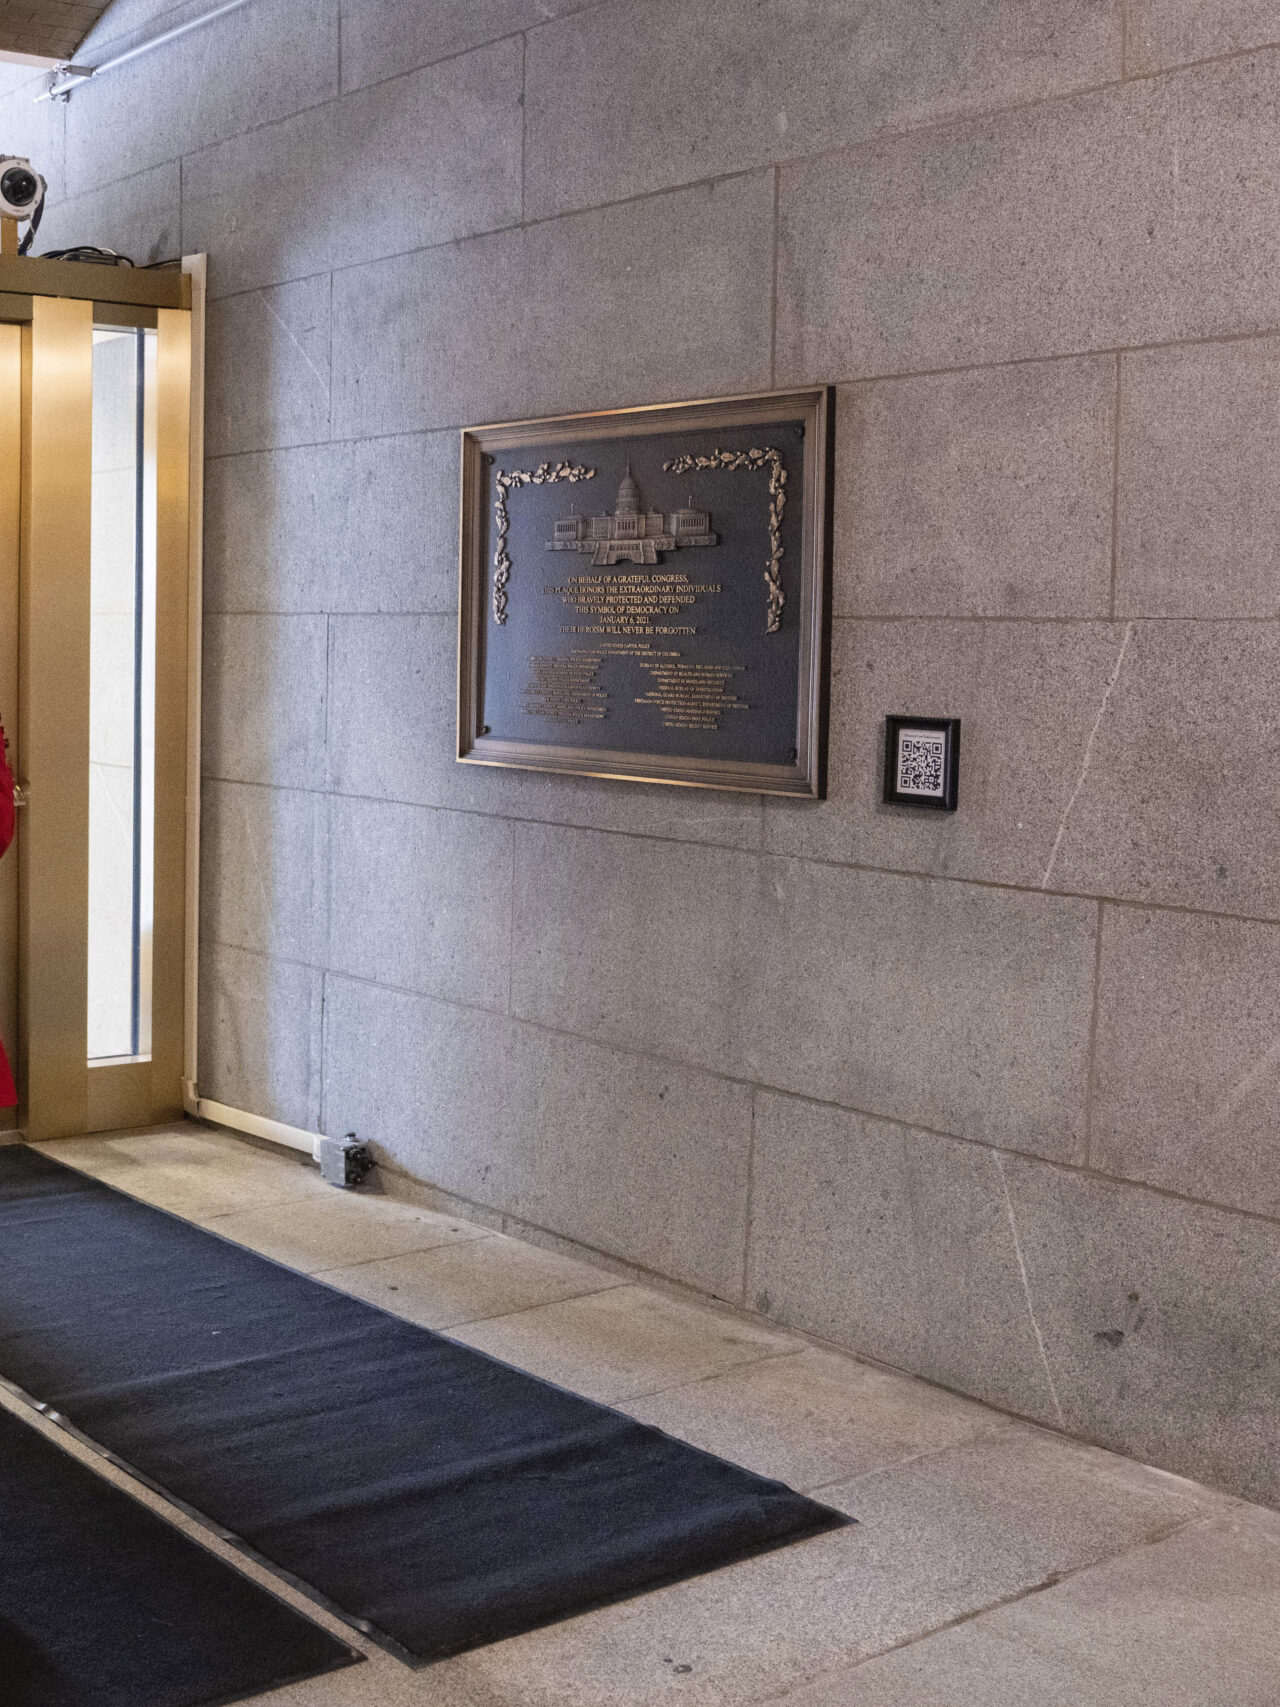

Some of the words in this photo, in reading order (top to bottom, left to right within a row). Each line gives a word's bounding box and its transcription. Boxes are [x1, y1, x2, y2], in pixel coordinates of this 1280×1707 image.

[603, 575, 611, 583] OF
[612, 575, 617, 583] A
[618, 575, 649, 583] GRATEFUL
[651, 574, 689, 583] CONGRESS,
[555, 586, 579, 595] PLAQUE
[580, 586, 605, 594] HONORS
[606, 585, 619, 593] THE
[619, 585, 675, 593] EXTRAORDINARY
[676, 584, 722, 593] INDIVIDUALS
[606, 595, 643, 603] PROTECTED
[659, 595, 696, 603] DEFENDED
[600, 616, 629, 624] JANUARY
[622, 626, 644, 634] NEVER
